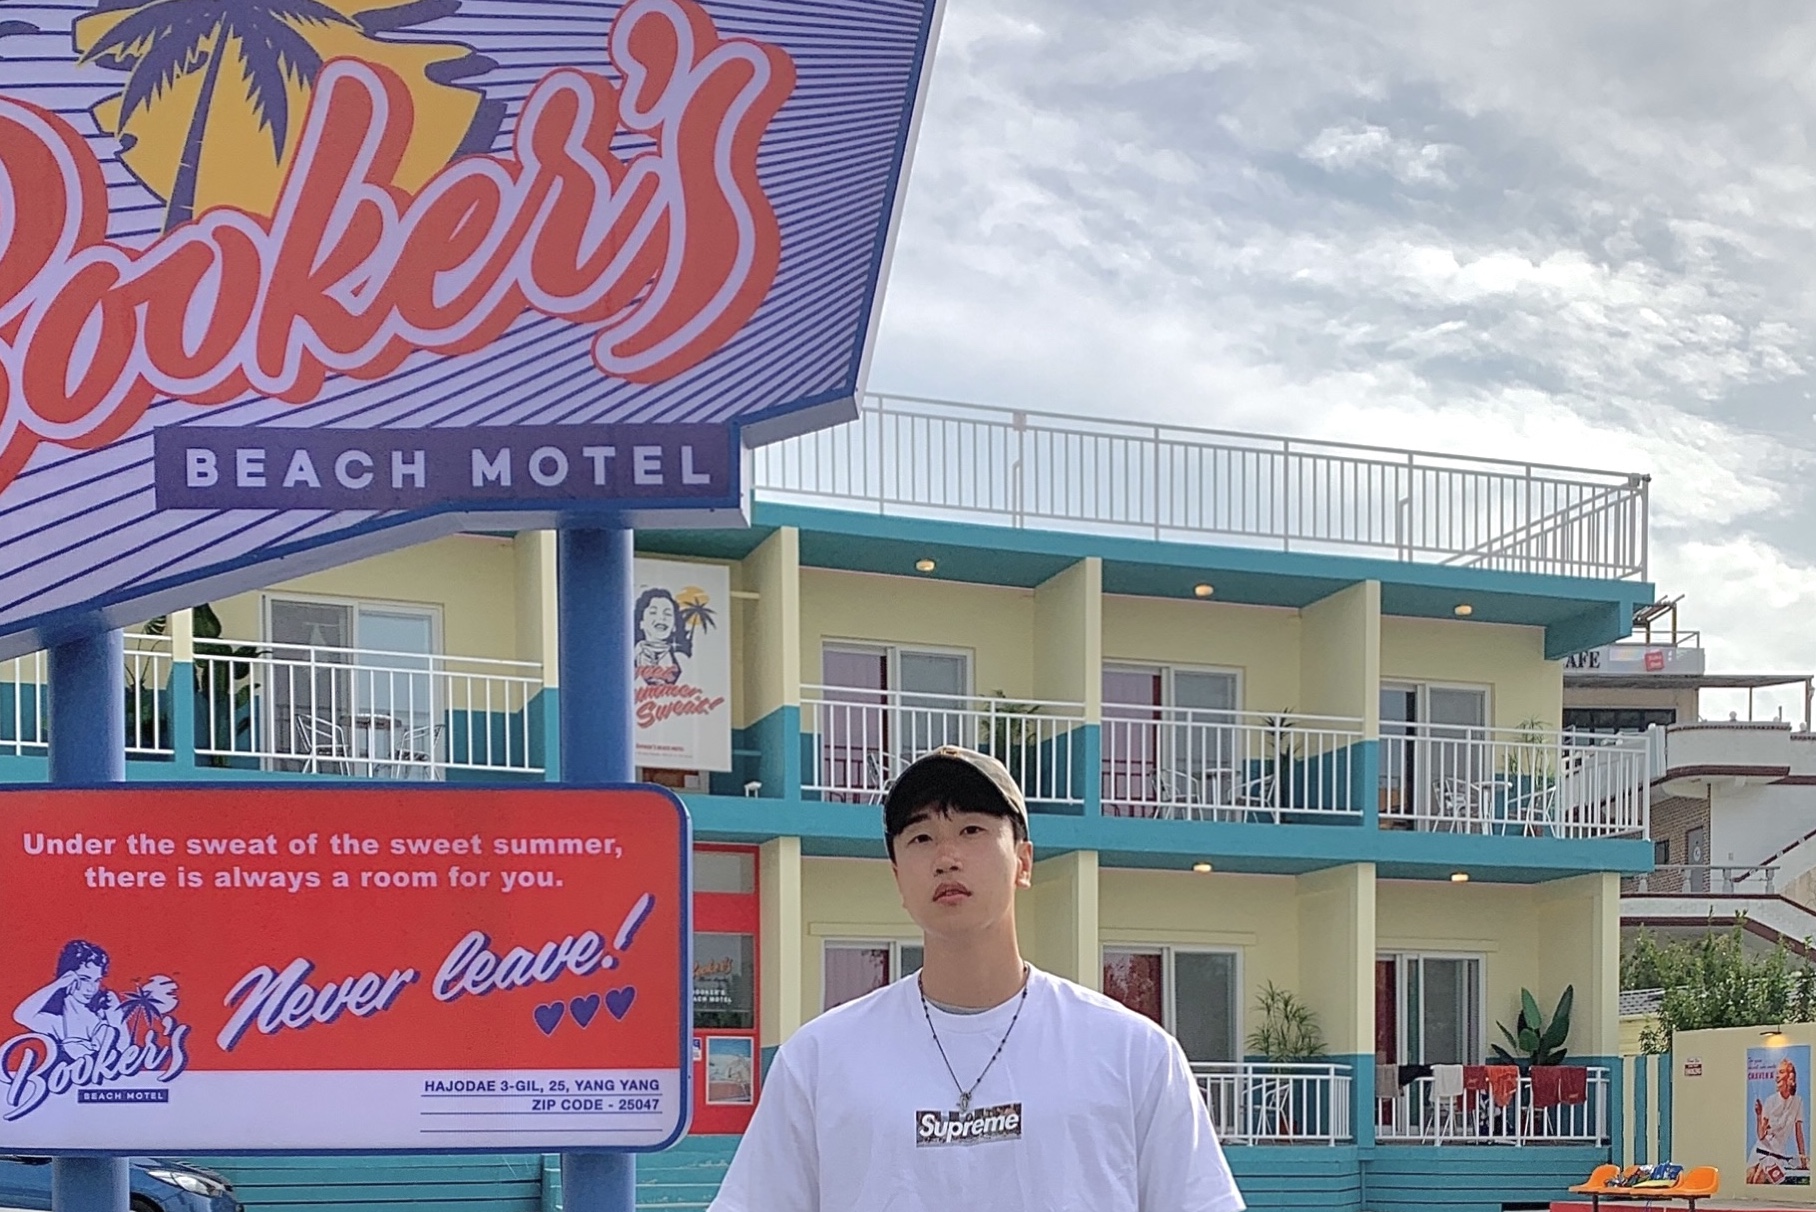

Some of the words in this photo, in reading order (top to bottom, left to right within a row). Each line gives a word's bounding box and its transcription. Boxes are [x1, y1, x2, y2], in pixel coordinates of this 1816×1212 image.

[0, 0, 797, 490] ooker's
[186, 448, 427, 490] BEACH
[472, 445, 711, 488] MOTEL
[1562, 651, 1600, 669] AFE
[22, 833, 117, 855] Under
[126, 833, 175, 855] the
[186, 834, 278, 855] sweat
[288, 833, 318, 855] of
[329, 833, 380, 855] the
[390, 834, 482, 855] sweet
[493, 835, 623, 860] summer,
[84, 866, 167, 888] there
[177, 866, 204, 888] is
[214, 866, 321, 893] always
[332, 871, 350, 888] a
[361, 871, 438, 888] room
[448, 866, 491, 888] for
[501, 871, 563, 893] you.
[217, 957, 420, 1051] Never
[432, 893, 655, 1001] leave!
[0, 1015, 191, 1121] Booker's
[83, 1091, 122, 1101] BEACH
[126, 1091, 164, 1100] MOTEL
[423, 1080, 497, 1092] HAJODAE
[499, 1080, 545, 1093] 3-GIL,
[548, 1080, 571, 1093] 25,
[574, 1079, 615, 1091] YANG
[619, 1079, 660, 1091] YANG
[531, 1098, 556, 1111] ZIP
[561, 1098, 603, 1111] CODE
[618, 1098, 660, 1111] 25047
[919, 1113, 1020, 1142] Supreme
